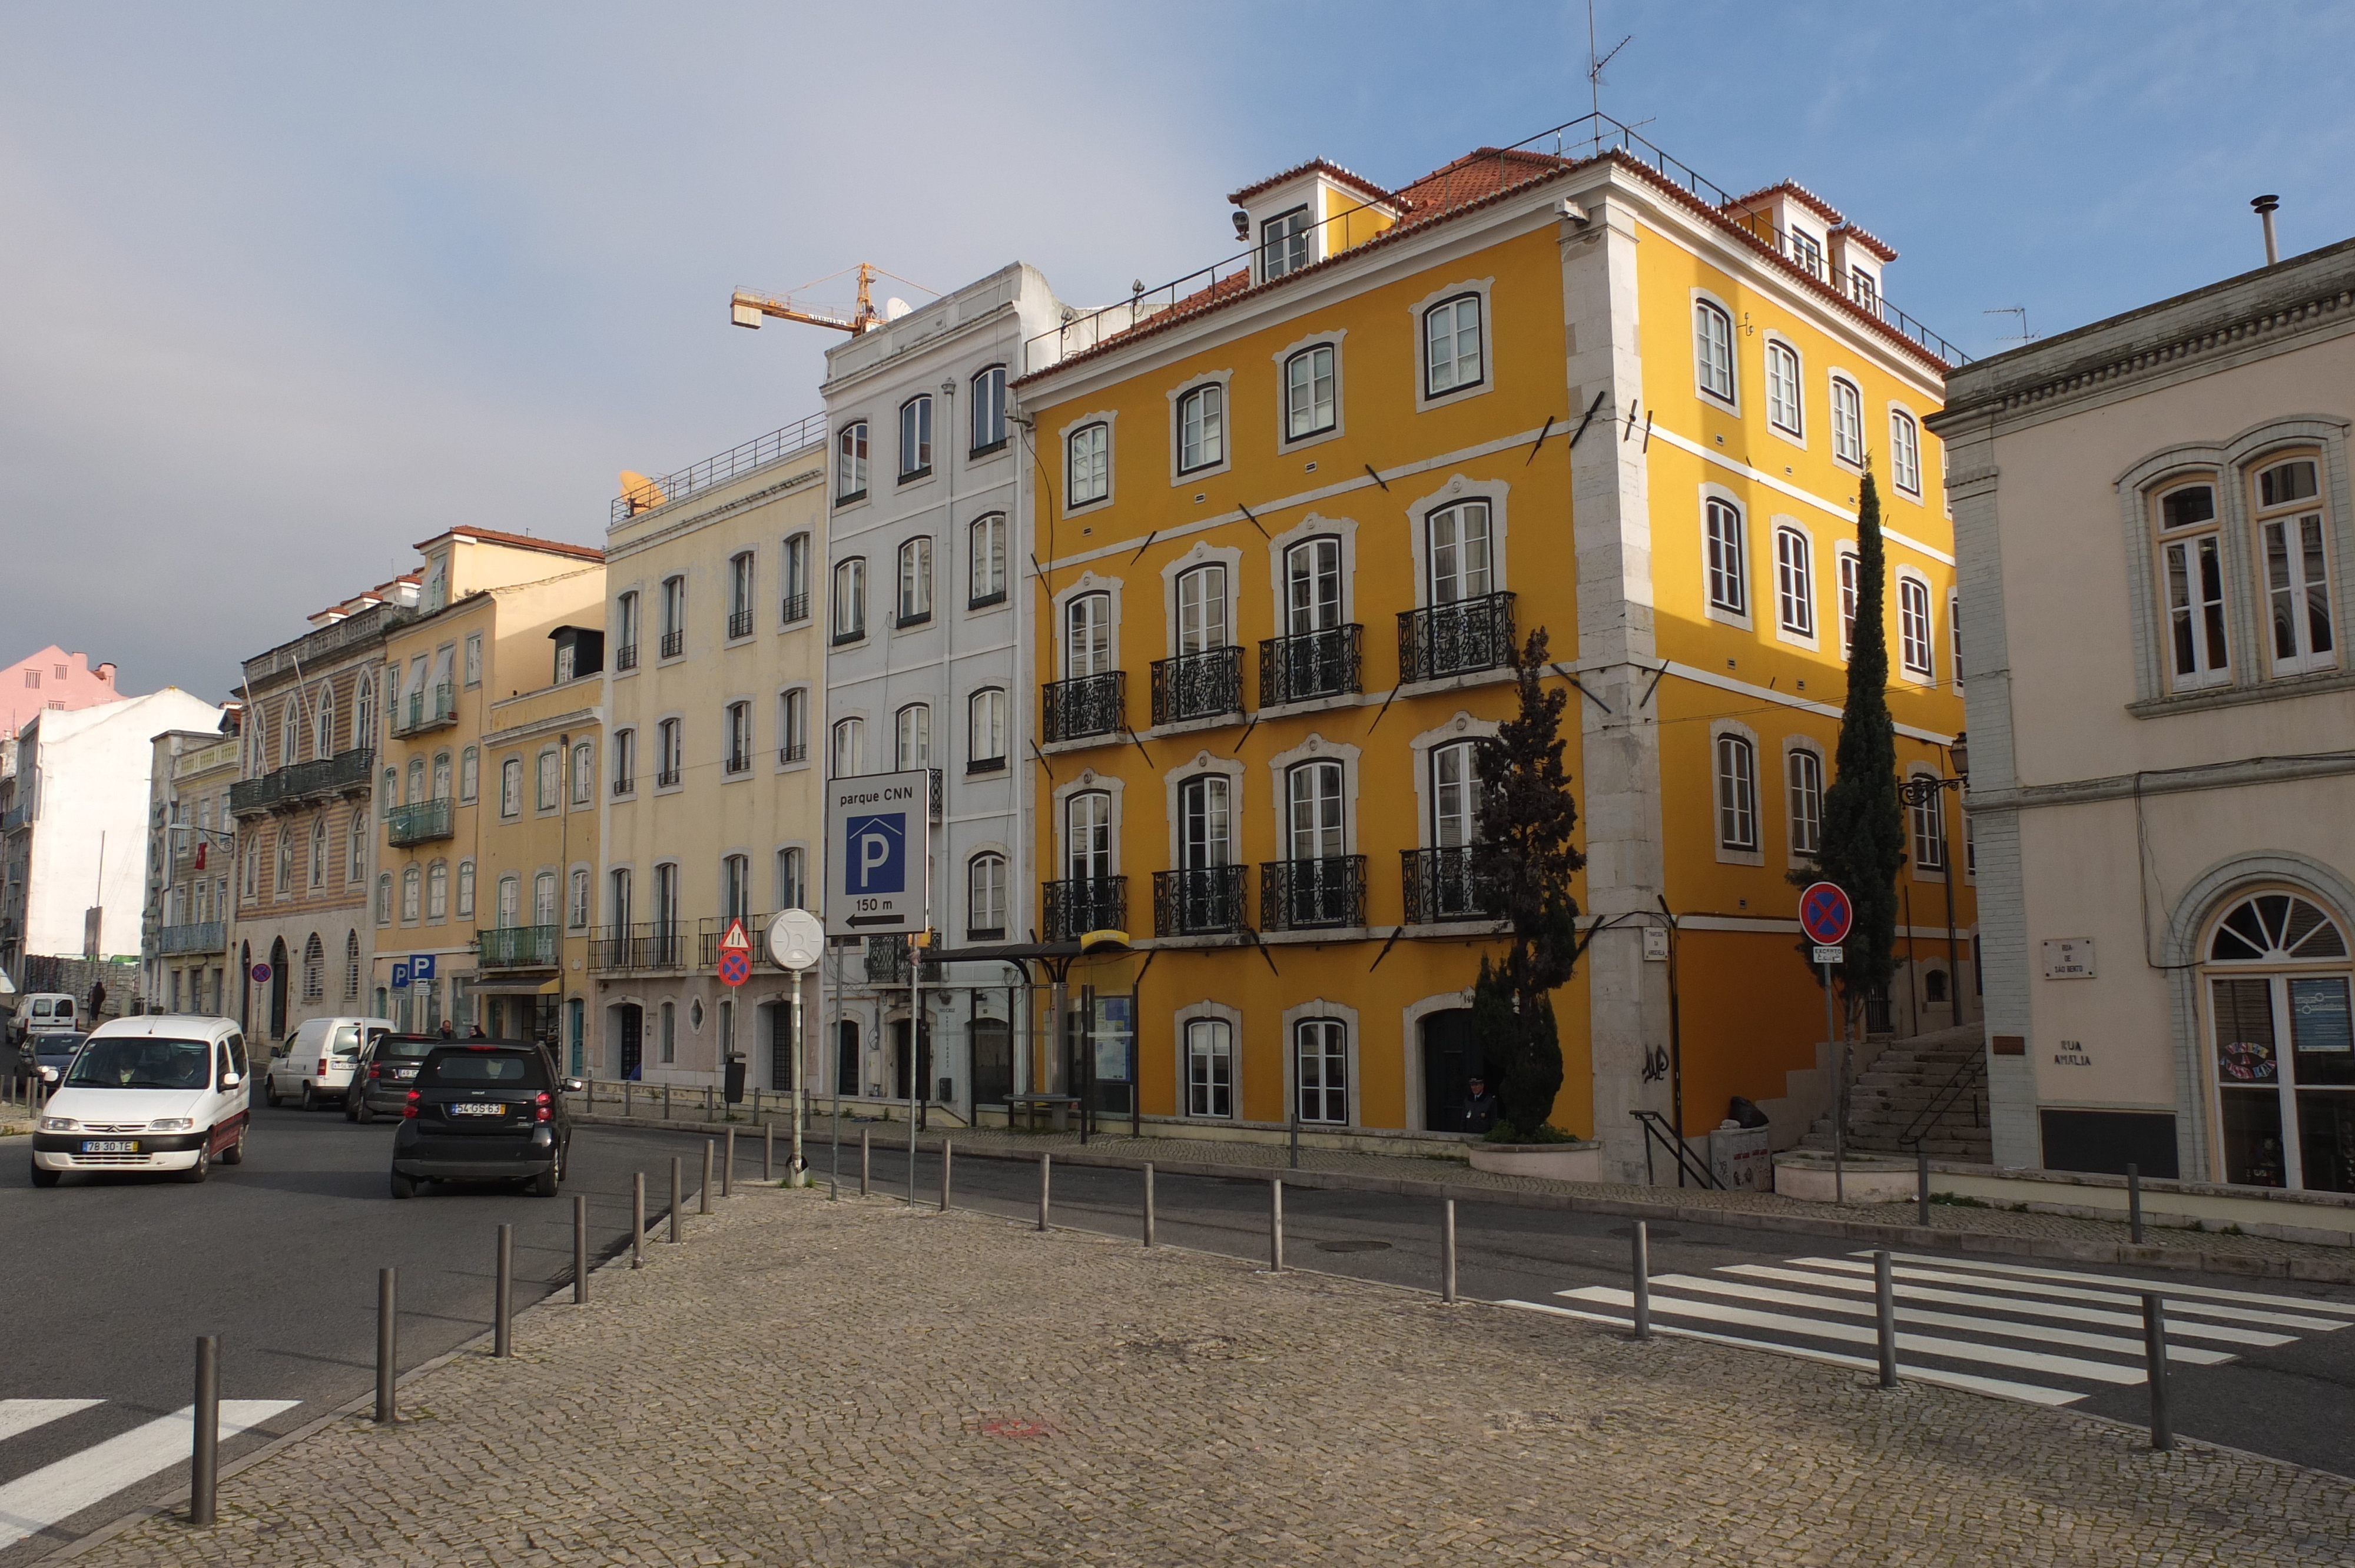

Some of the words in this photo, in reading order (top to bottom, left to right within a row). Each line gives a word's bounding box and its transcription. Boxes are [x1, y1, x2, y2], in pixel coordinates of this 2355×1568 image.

[840, 792, 880, 808] parque
[884, 786, 913, 800] CNN
[861, 833, 890, 887] P
[856, 898, 877, 911] 150
[883, 900, 893, 910] m
[396, 966, 407, 984] P
[414, 958, 430, 977] P
[2061, 1040, 2082, 1051] RUA
